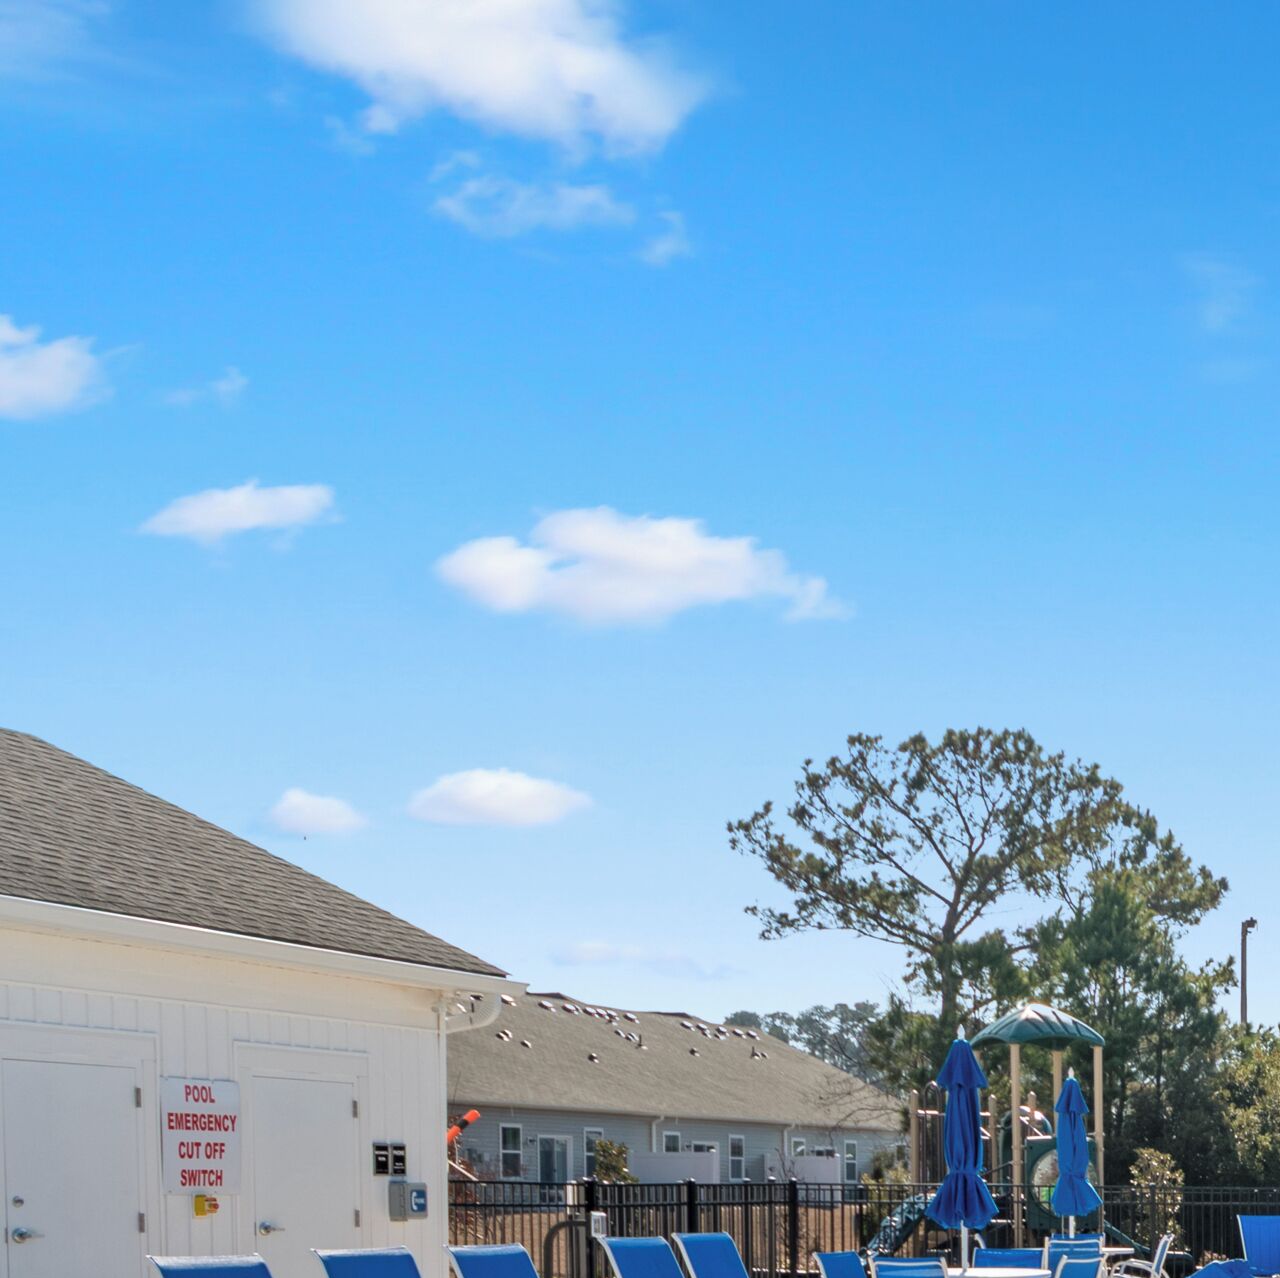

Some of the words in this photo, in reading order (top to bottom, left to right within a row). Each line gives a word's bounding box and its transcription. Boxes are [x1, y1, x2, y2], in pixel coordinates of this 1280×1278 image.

[184, 1084, 216, 1104] POOL
[166, 1111, 237, 1133] EMERGENCY
[178, 1141, 202, 1160] CUT
[204, 1142, 226, 1160] OFF
[180, 1168, 223, 1188] SWITCH
